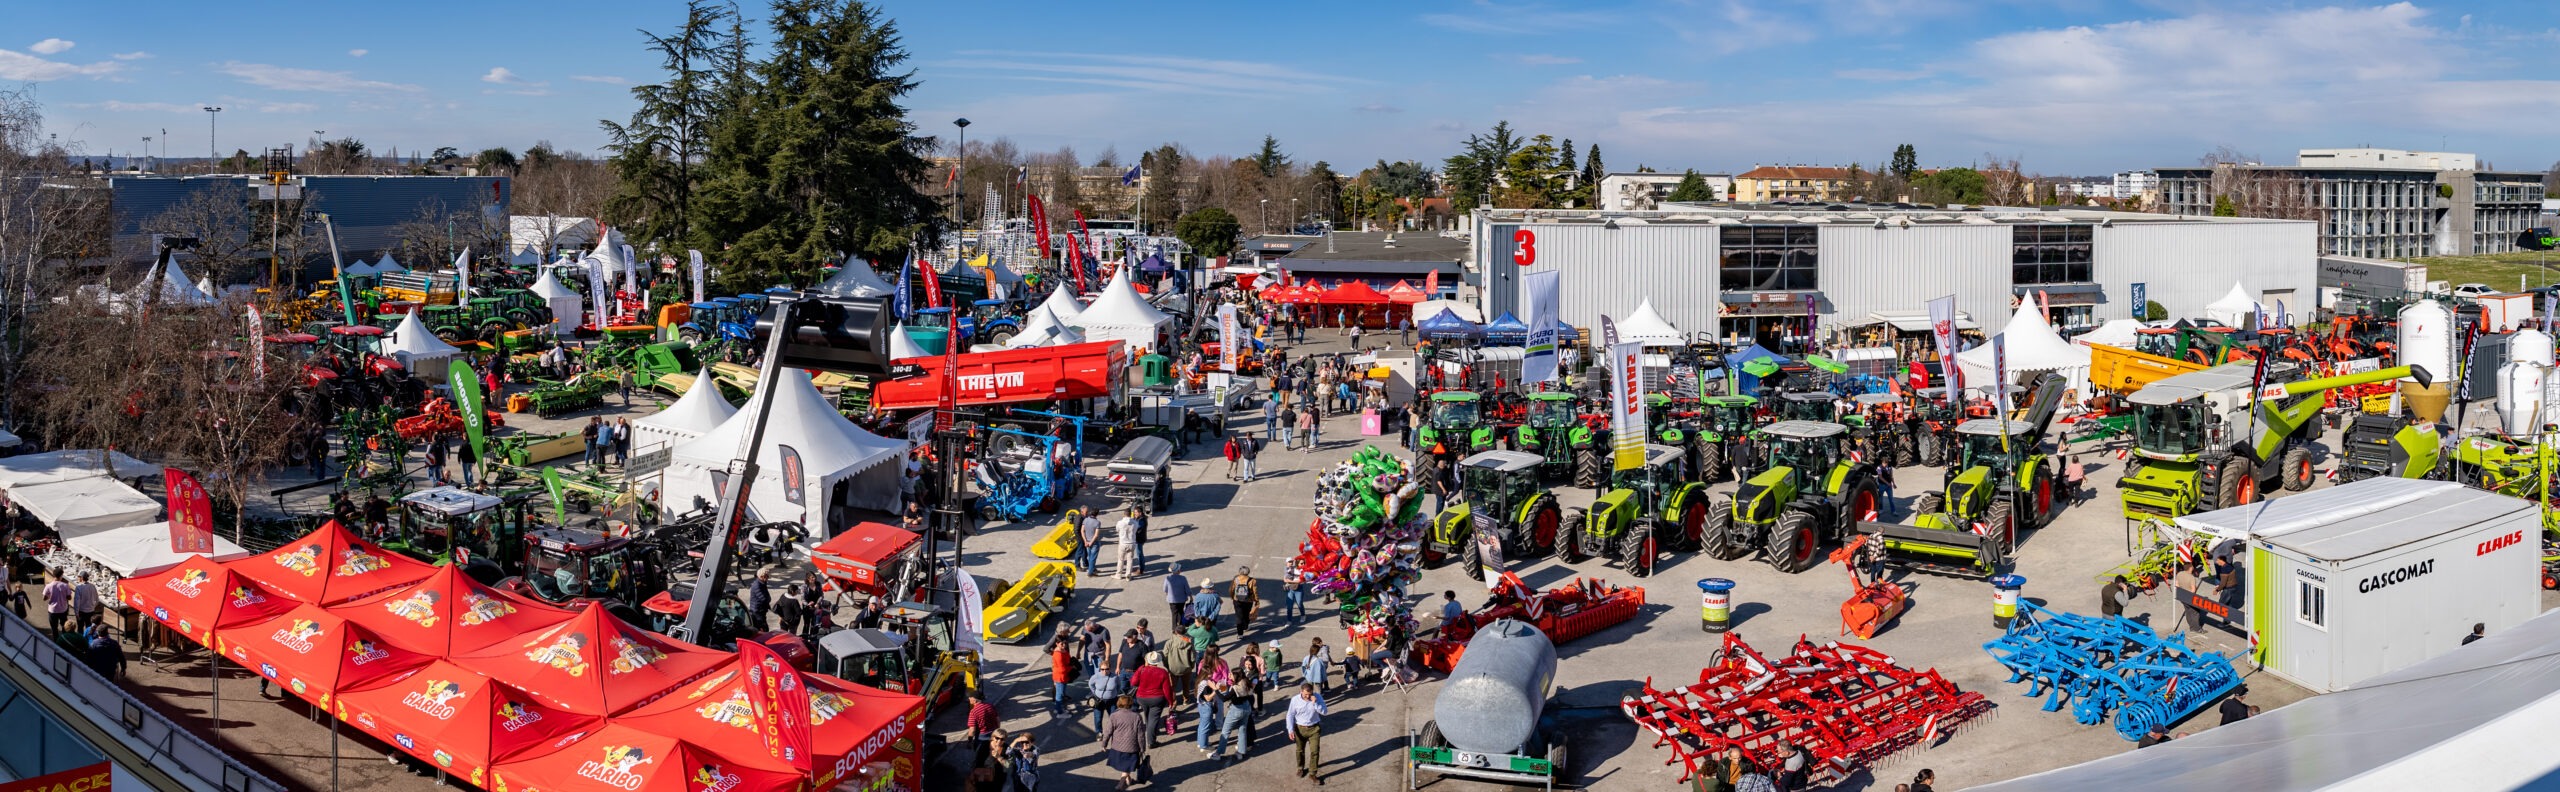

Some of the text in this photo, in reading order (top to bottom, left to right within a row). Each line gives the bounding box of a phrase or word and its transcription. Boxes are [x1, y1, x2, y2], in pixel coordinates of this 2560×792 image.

[1514, 229, 1536, 266] 3
[2461, 327, 2479, 400] GASCOMAT
[957, 371, 1024, 391] THIEVIN
[2476, 530, 2523, 556] CLAAS
[2296, 568, 2326, 584] GASCOMAT
[2359, 559, 2434, 594] GASCOMAT
[166, 578, 201, 599] HARIBO
[2192, 595, 2229, 618] CLAAS
[272, 629, 314, 654] HARIBO
[352, 649, 389, 665] HARIBO
[402, 691, 455, 720] HARIBO
[726, 704, 753, 716] HARIB
[503, 711, 542, 732] HARIBO
[835, 715, 905, 779] BONBONS
[1461, 753, 1469, 762] 25
[578, 761, 642, 790] HARIBO
